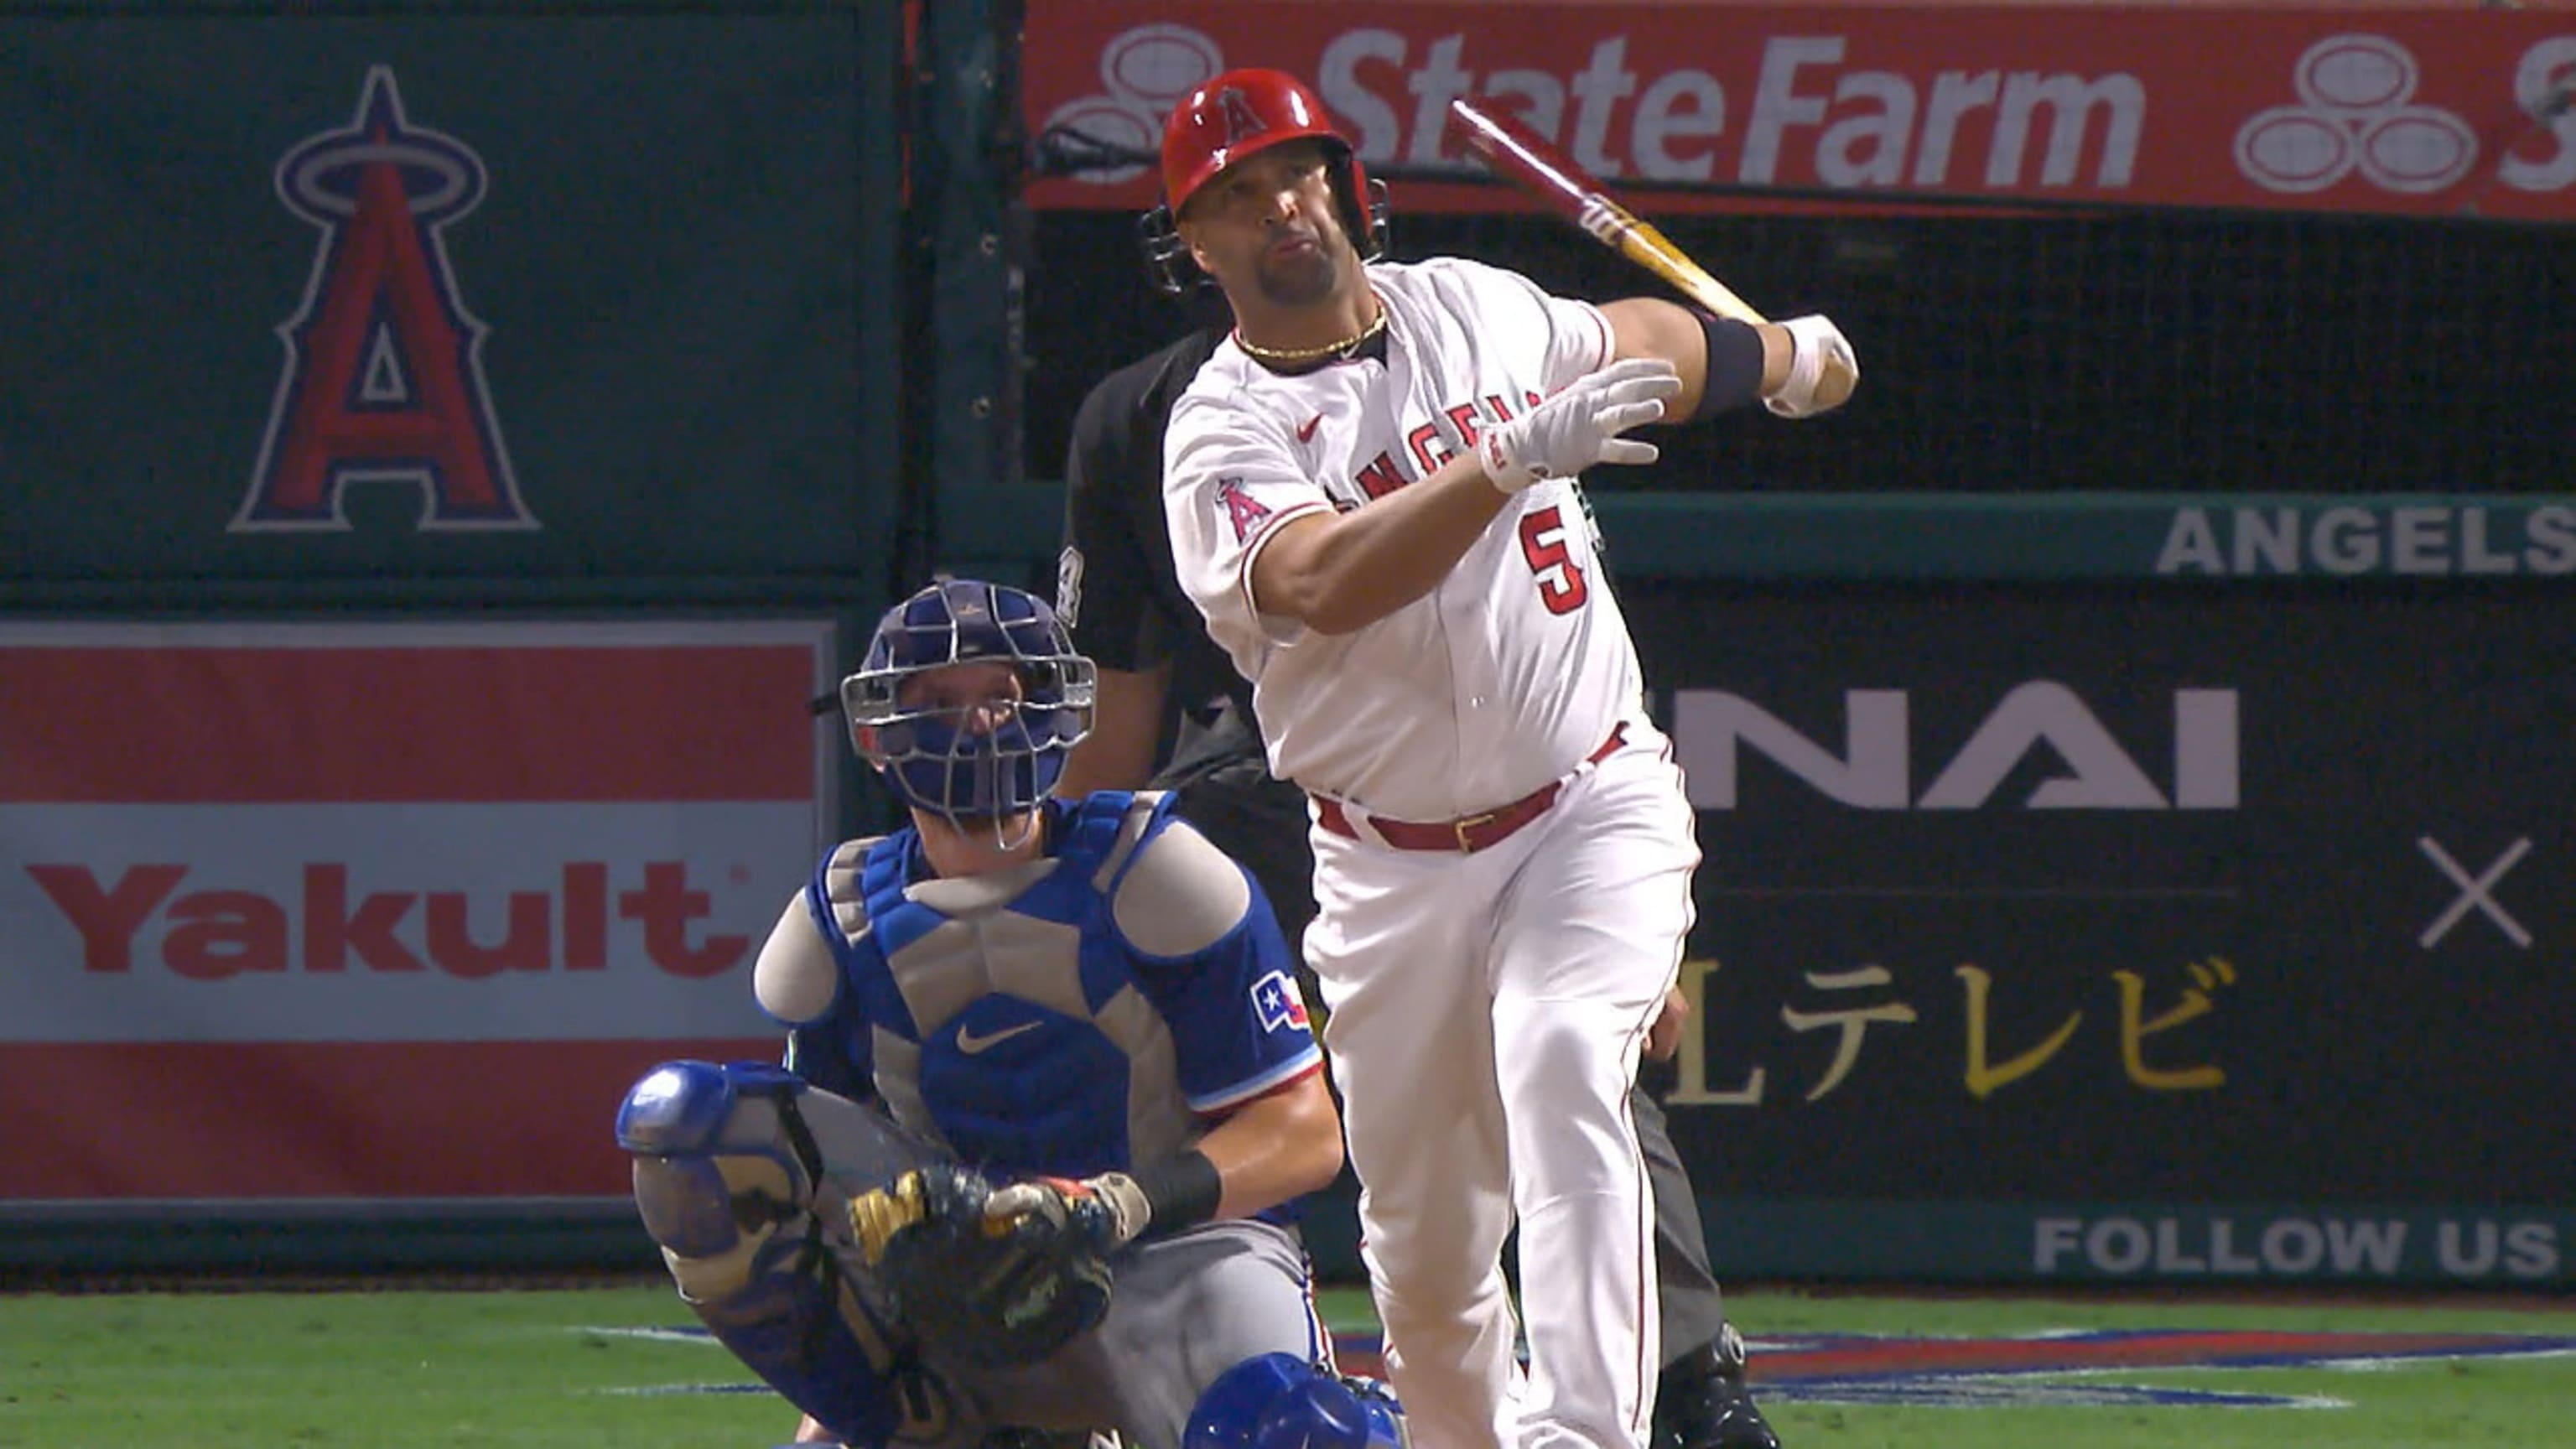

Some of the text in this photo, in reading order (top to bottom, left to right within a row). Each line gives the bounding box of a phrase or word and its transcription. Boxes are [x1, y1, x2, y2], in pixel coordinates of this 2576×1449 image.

[1218, 85, 1269, 148] A
[1738, 36, 2147, 189] Farm
[226, 64, 543, 532] A
[1214, 476, 1272, 547] A
[1518, 505, 1587, 615] 5
[2156, 506, 2576, 574] ANGELS
[1675, 679, 2240, 809] NAI
[23, 861, 749, 979] Yakult
[2033, 1218, 2558, 1277] FOLLOW US
